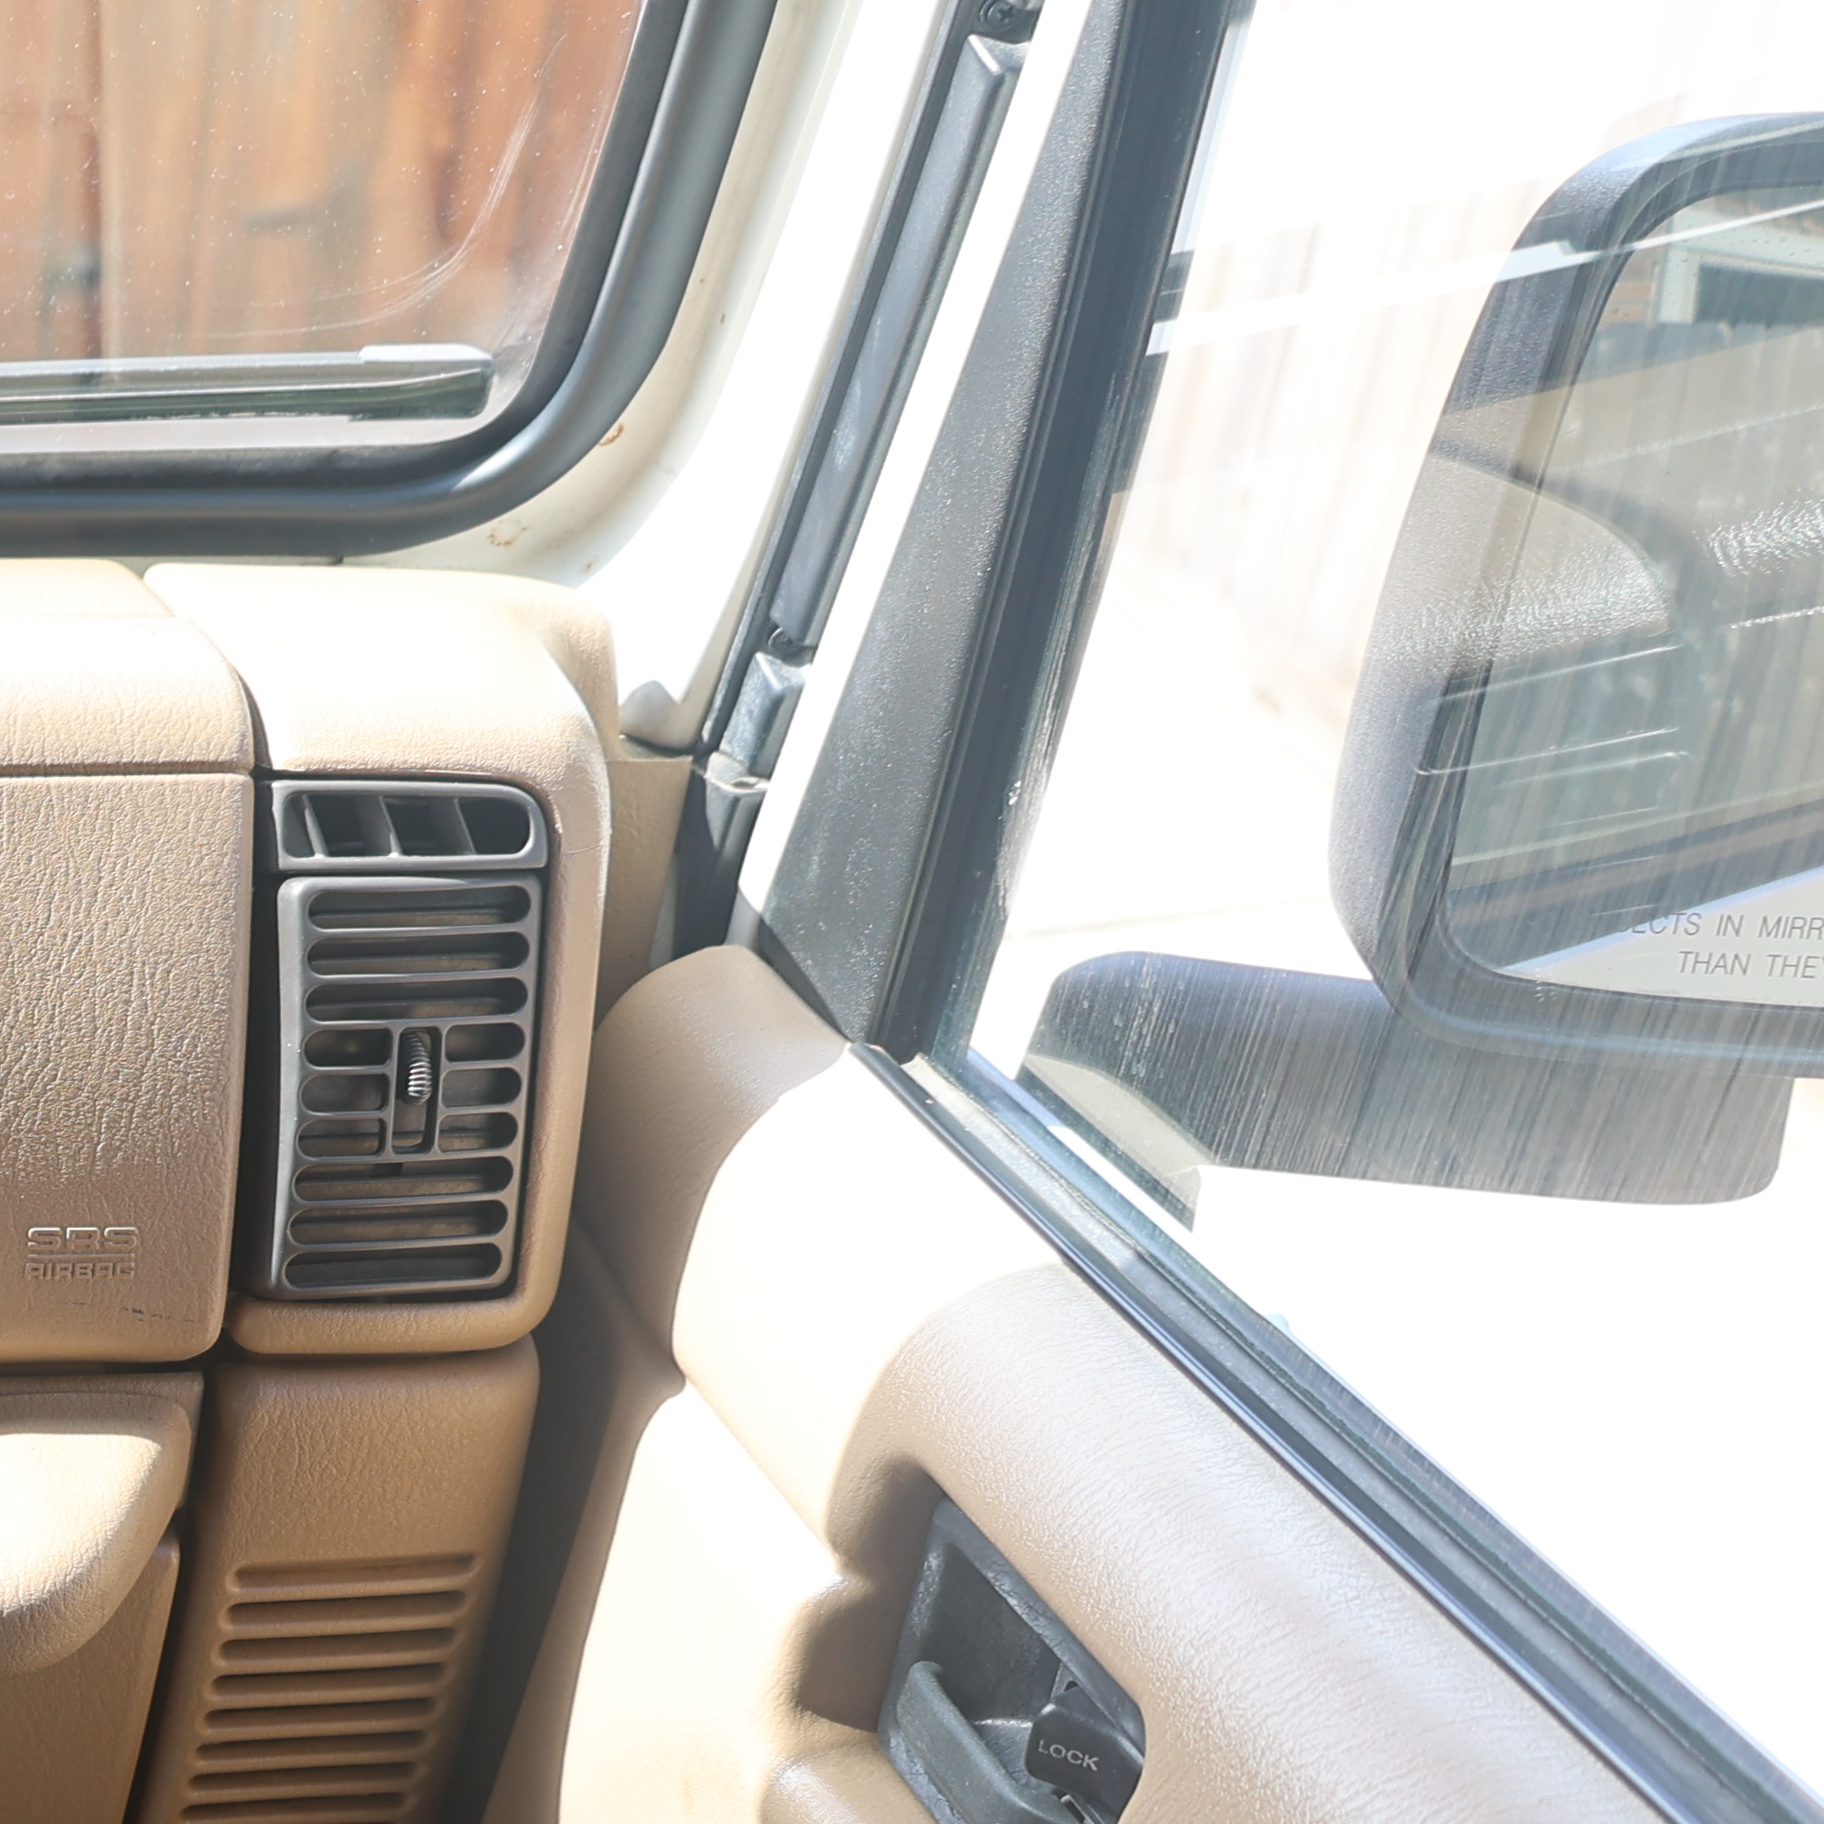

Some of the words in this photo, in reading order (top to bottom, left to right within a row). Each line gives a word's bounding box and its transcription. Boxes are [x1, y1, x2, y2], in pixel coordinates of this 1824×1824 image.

[1715, 914, 1743, 937] IN
[1679, 950, 1751, 976] THAN
[27, 1226, 139, 1251] SRS
[24, 1261, 136, 1281] AIRBAG
[1038, 1739, 1101, 1772] LOCK
